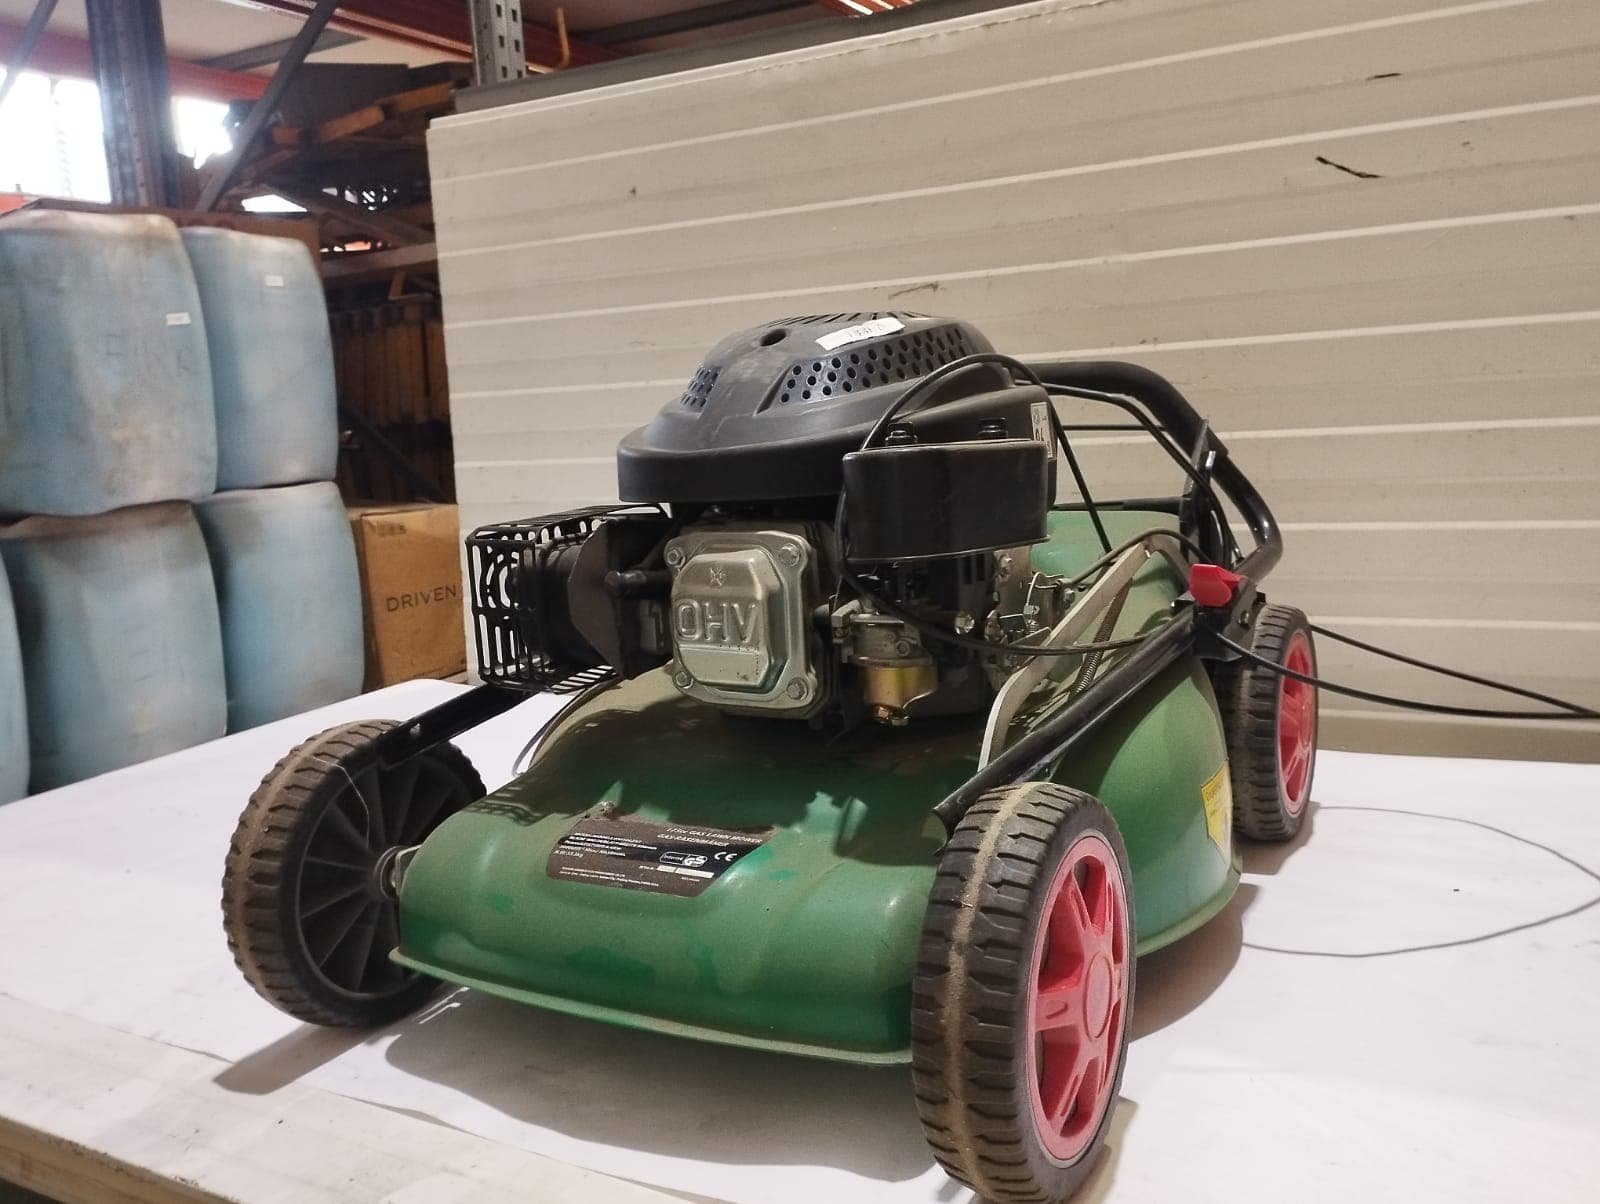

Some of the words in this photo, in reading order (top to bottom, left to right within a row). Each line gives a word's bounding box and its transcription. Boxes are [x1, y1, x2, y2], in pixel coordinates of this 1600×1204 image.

[386, 583, 457, 612] DRIVEN
[676, 599, 761, 643] OHV
[684, 855, 707, 866] GS
